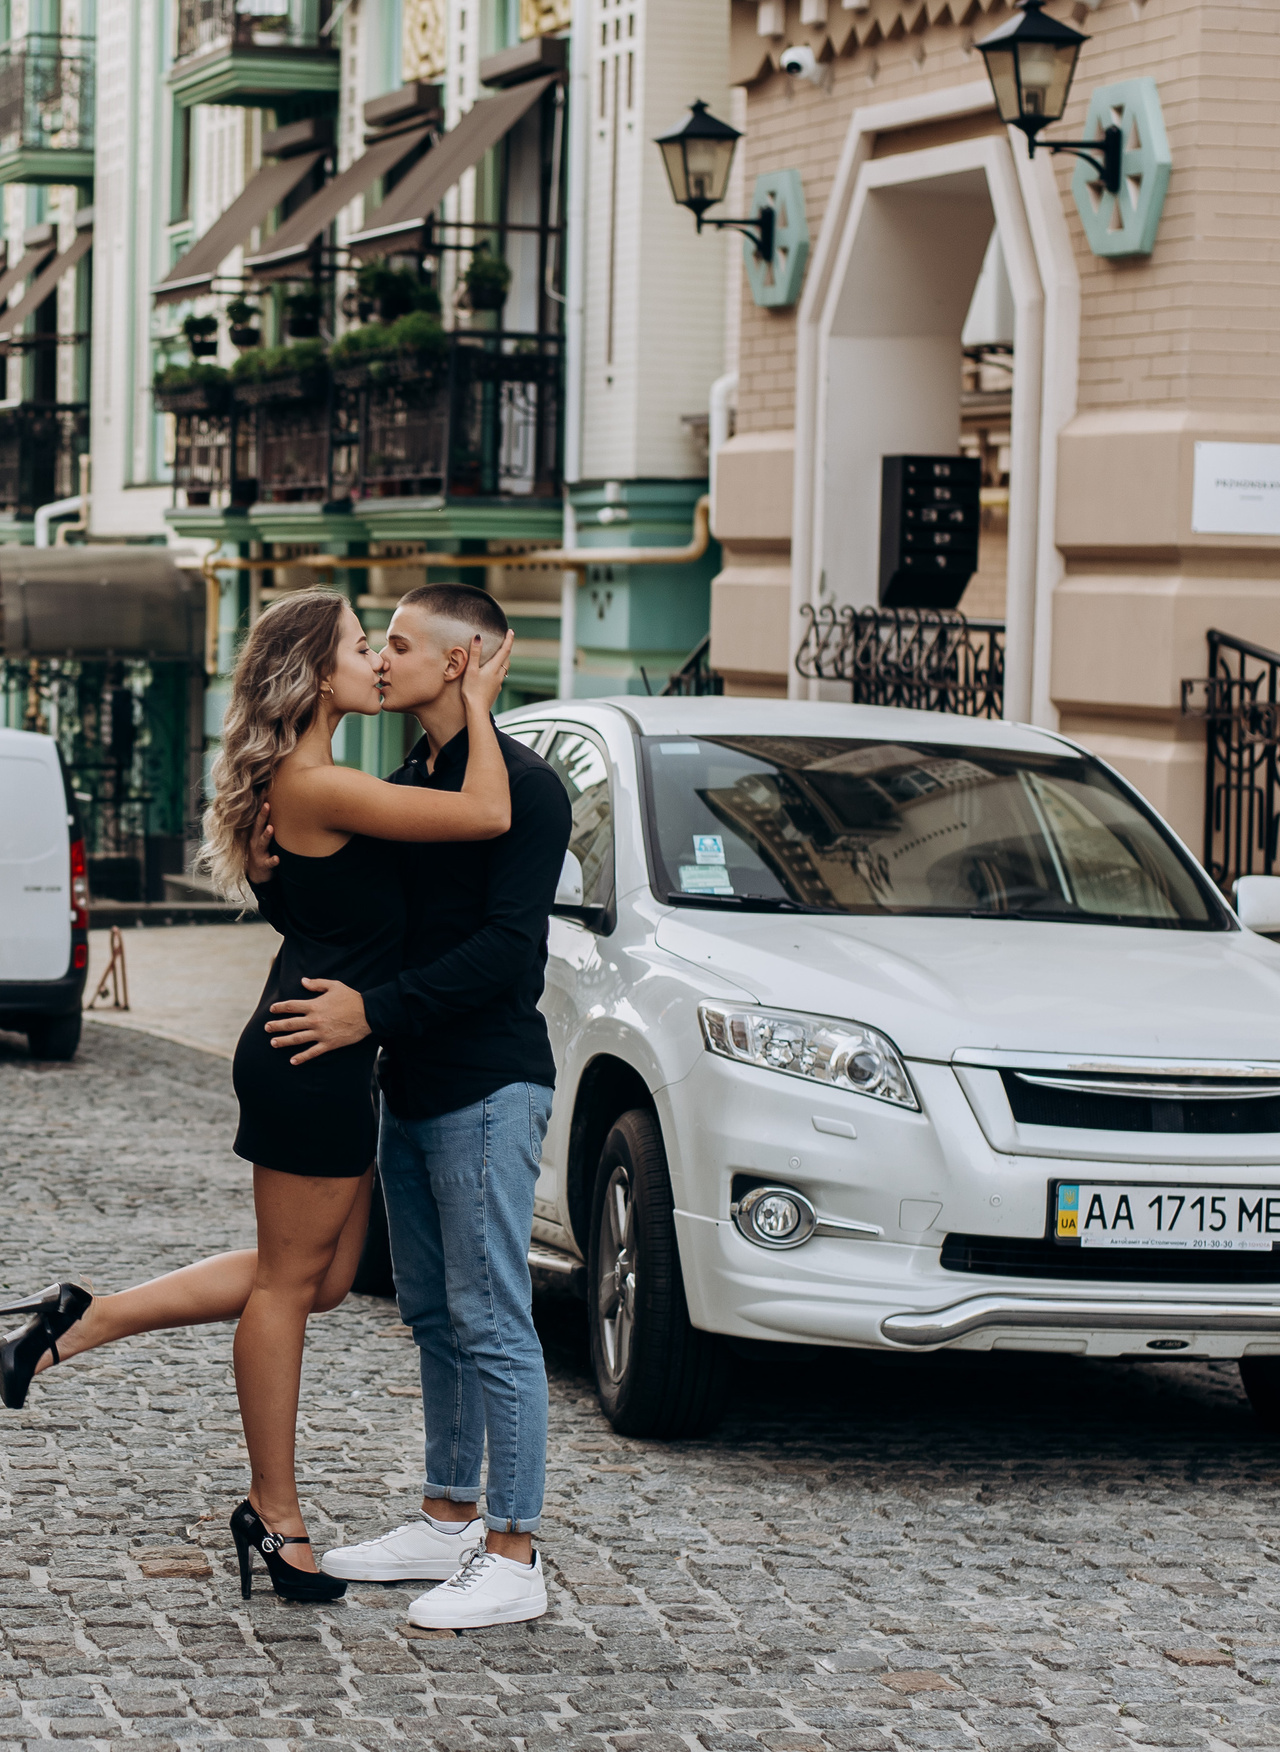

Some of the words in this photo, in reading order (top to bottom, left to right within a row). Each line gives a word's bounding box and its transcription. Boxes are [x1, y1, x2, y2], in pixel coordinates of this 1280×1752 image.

[1084, 1193, 1135, 1231] AA
[1148, 1195, 1227, 1232] 1715
[1061, 1218, 1077, 1229] UA
[1193, 1239, 1234, 1248] 201-30-30
